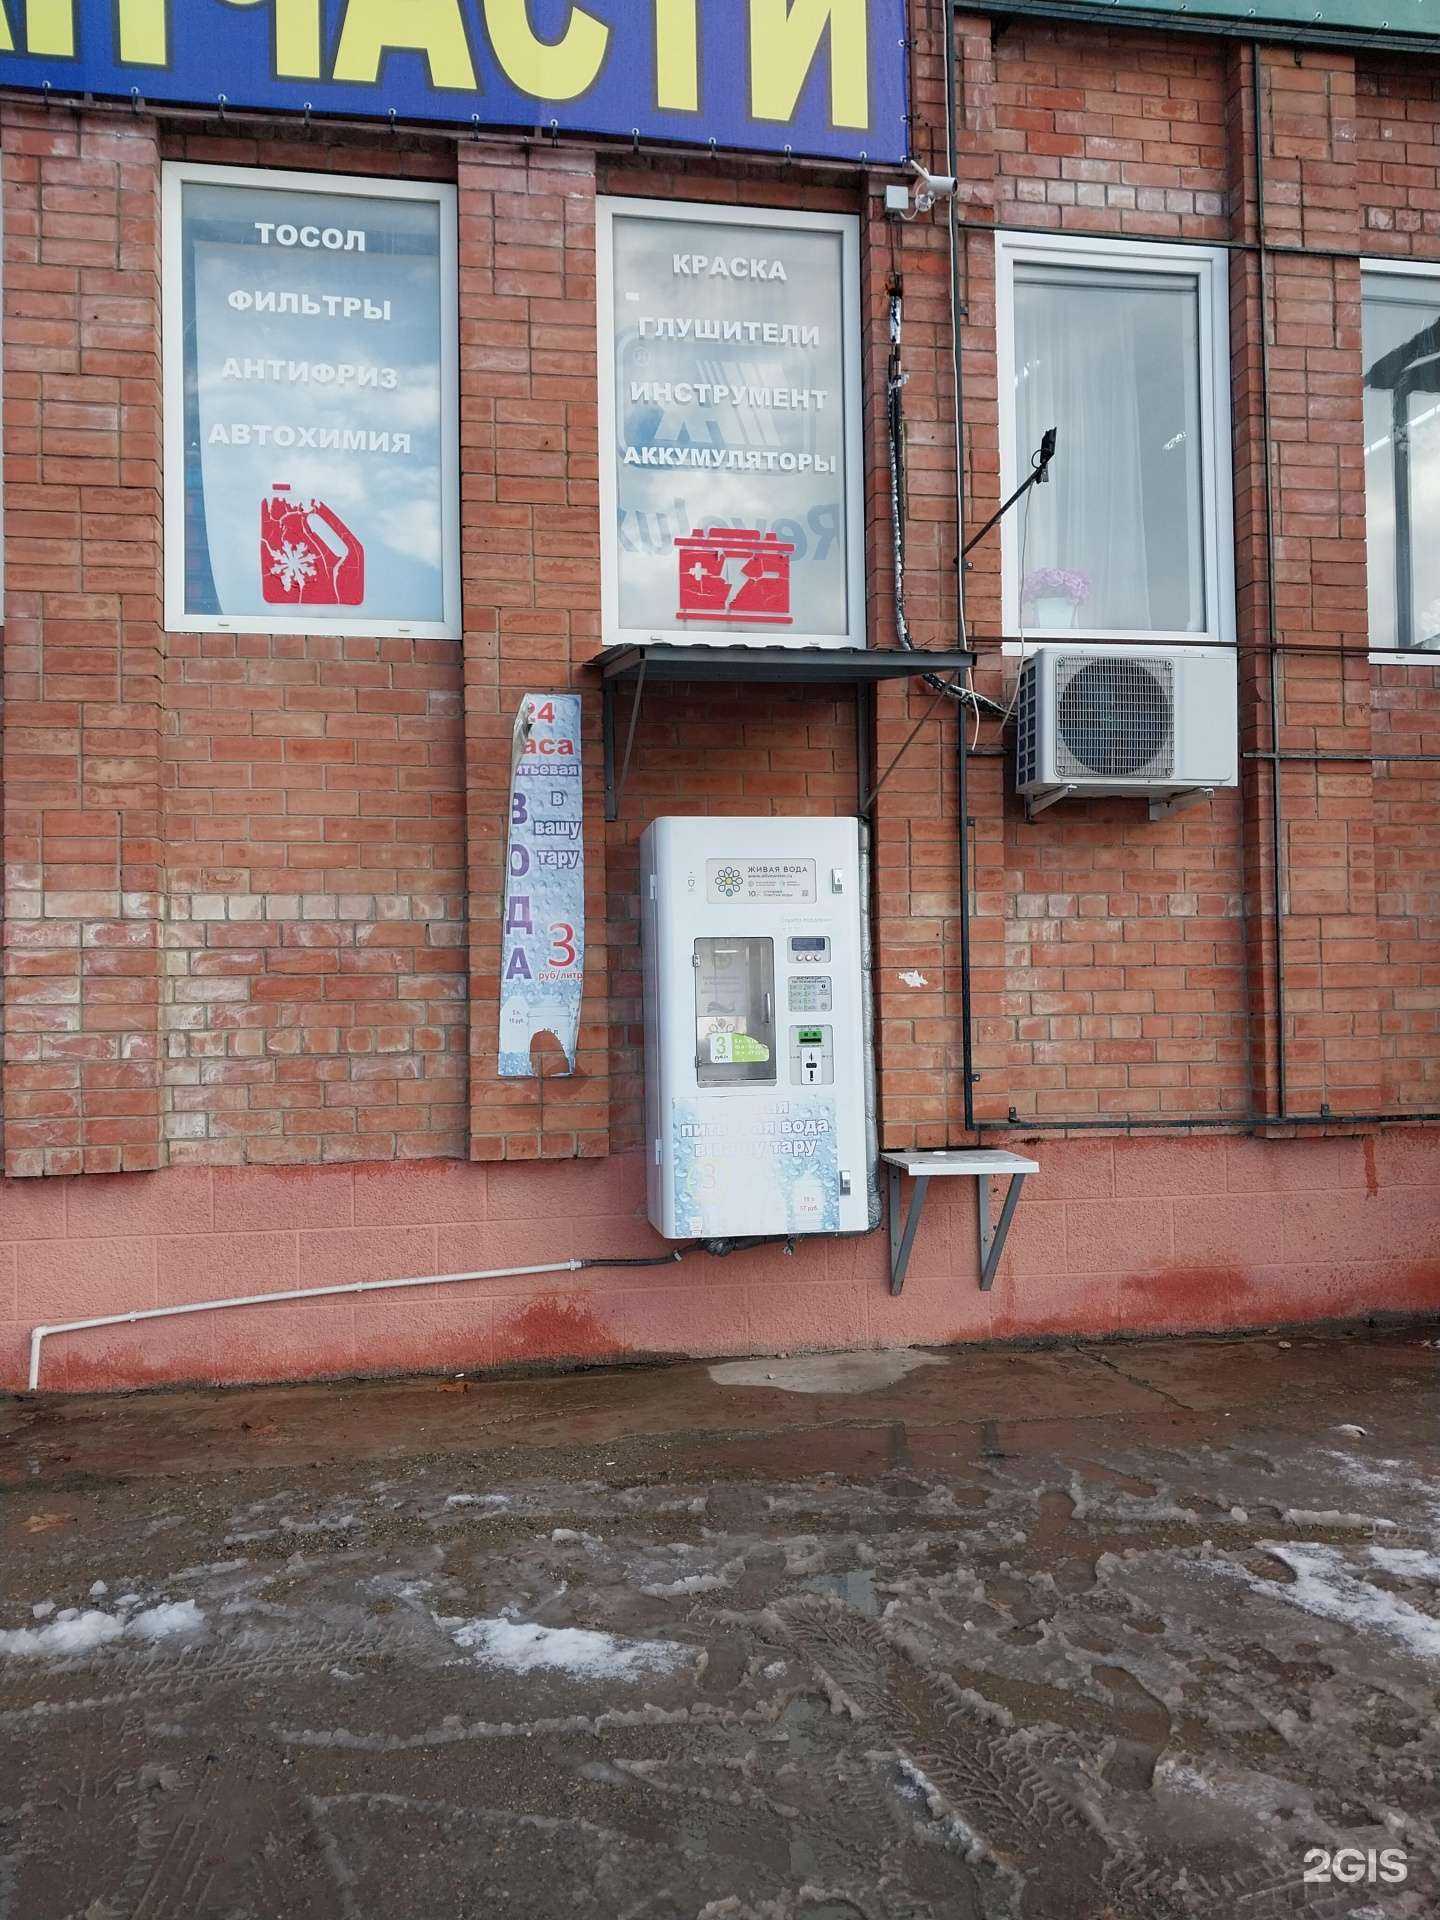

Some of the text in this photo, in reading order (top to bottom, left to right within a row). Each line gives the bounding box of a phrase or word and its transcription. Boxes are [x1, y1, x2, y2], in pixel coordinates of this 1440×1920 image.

[254, 222, 366, 252] ТОСОЛ
[672, 253, 787, 281] КРАСКА
[227, 289, 392, 321] ФИЛЬТРЫ
[638, 316, 820, 346] ГЛУШИТЕЛИ
[221, 357, 398, 389] АНТИФРИЗ
[630, 381, 830, 410] ИНСТРУМЕНТ
[207, 422, 411, 454] АВТОХИМИЯ
[623, 446, 836, 473] АККУМУЛЯТОРЫ
[534, 820, 582, 840] вашу
[537, 850, 579, 869] тару
[549, 922, 576, 968] 3
[716, 1036, 726, 1055] 3
[781, 1117, 830, 1136] вода
[771, 1138, 818, 1158] тару
